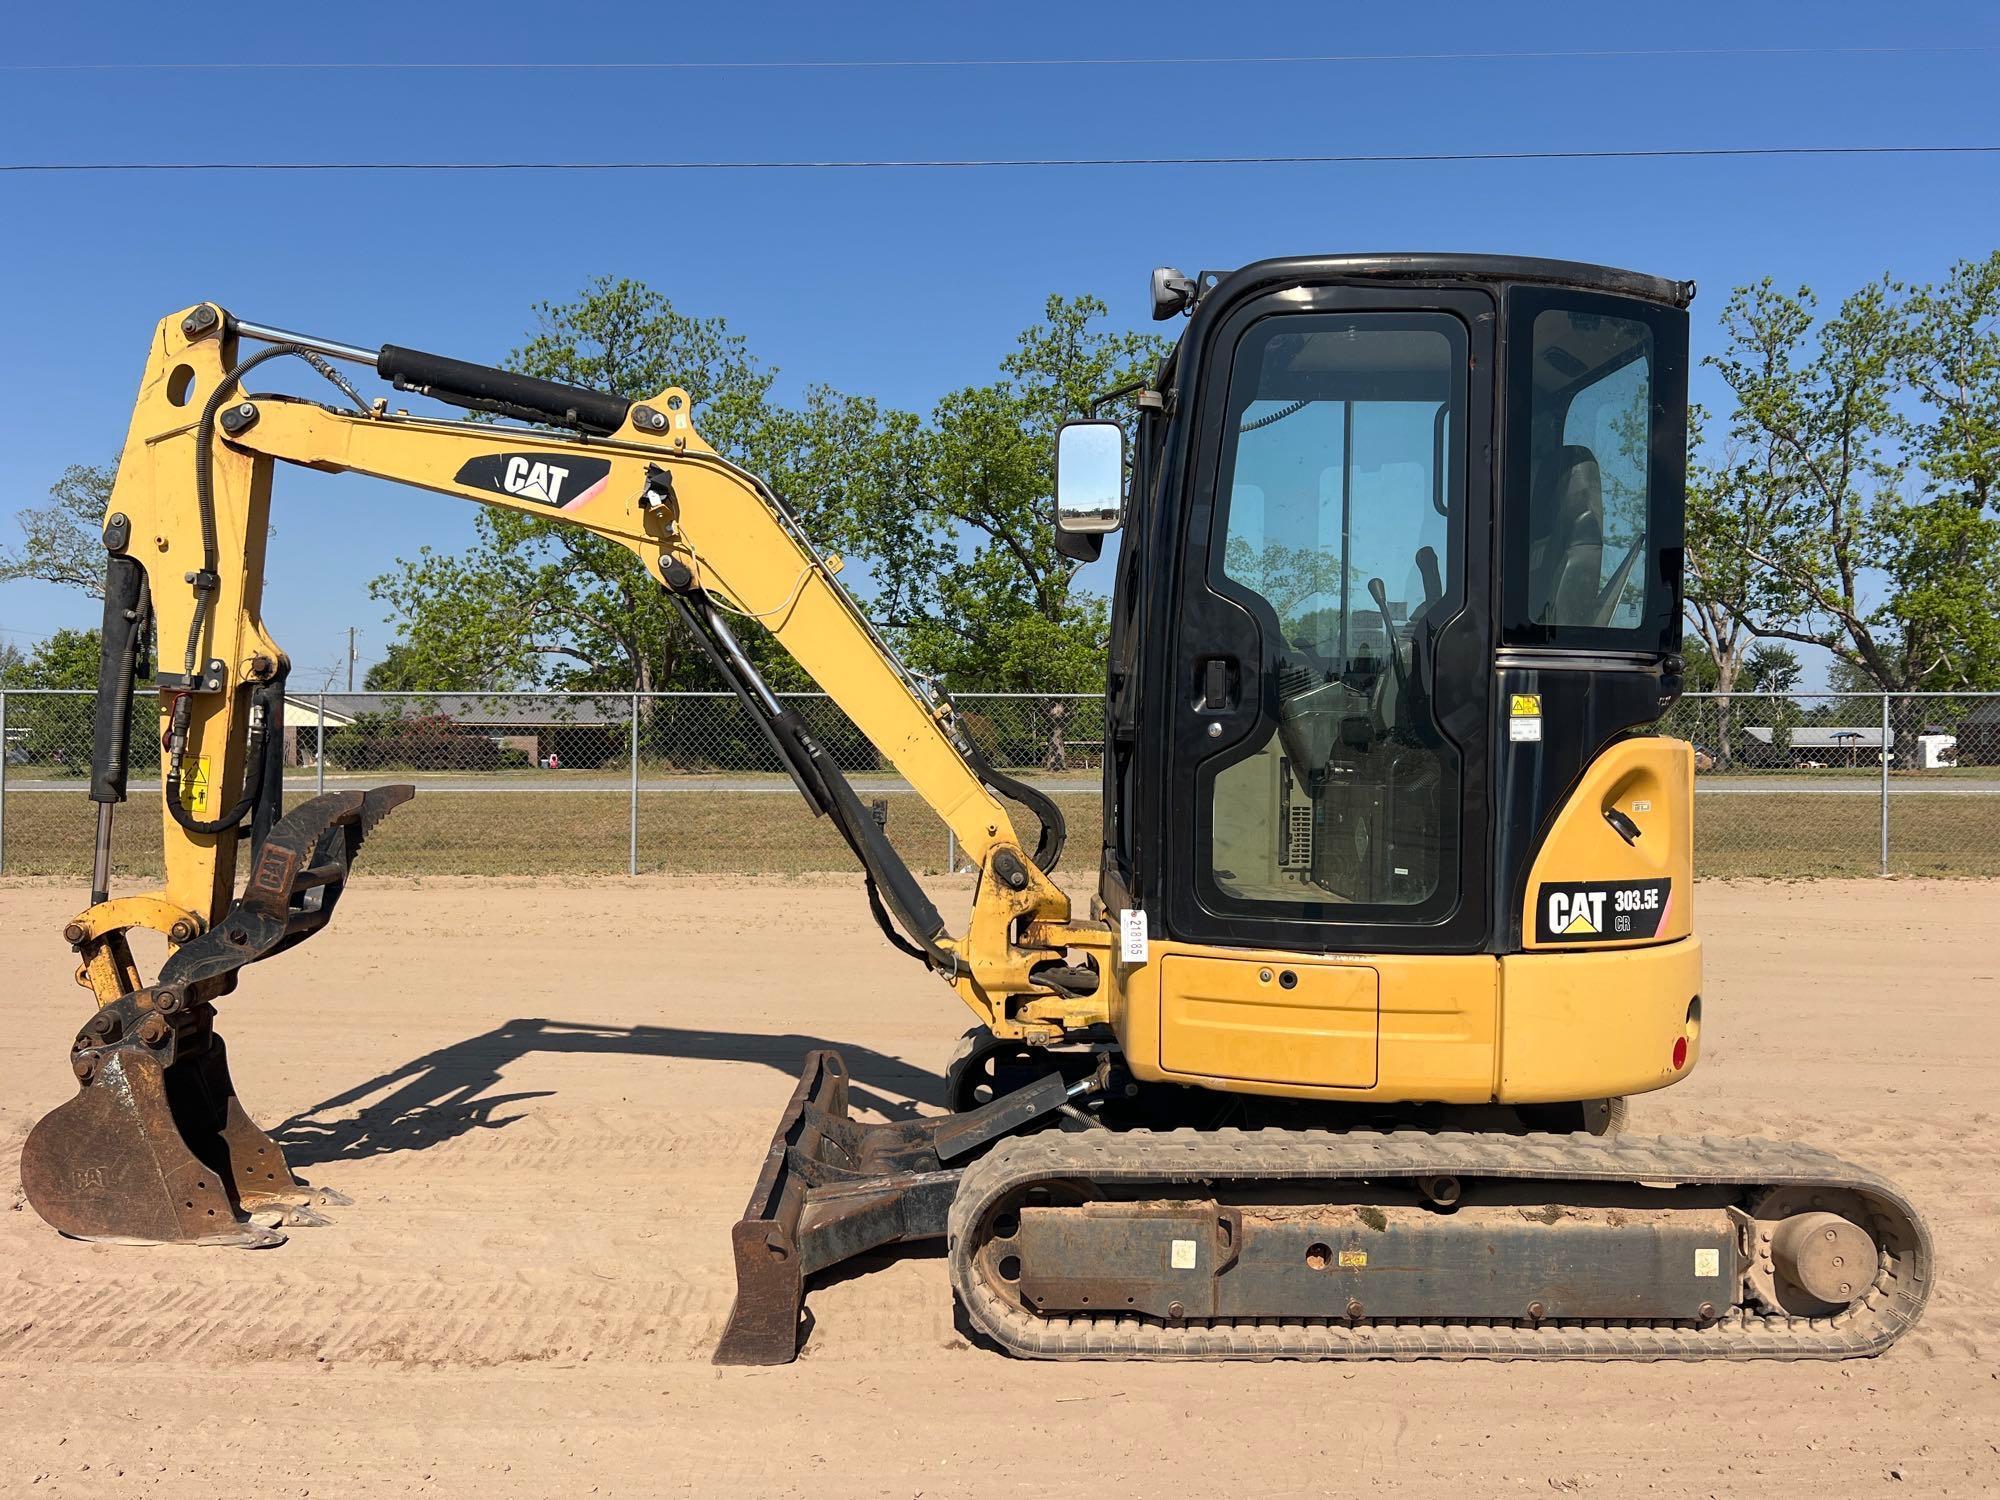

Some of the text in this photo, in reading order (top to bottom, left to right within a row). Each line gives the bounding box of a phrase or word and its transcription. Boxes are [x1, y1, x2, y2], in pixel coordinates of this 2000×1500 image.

[503, 456, 570, 504] CAT
[1548, 891, 1607, 935] CAT
[1614, 888, 1659, 912] 303.5E
[1614, 915, 1631, 932] CR
